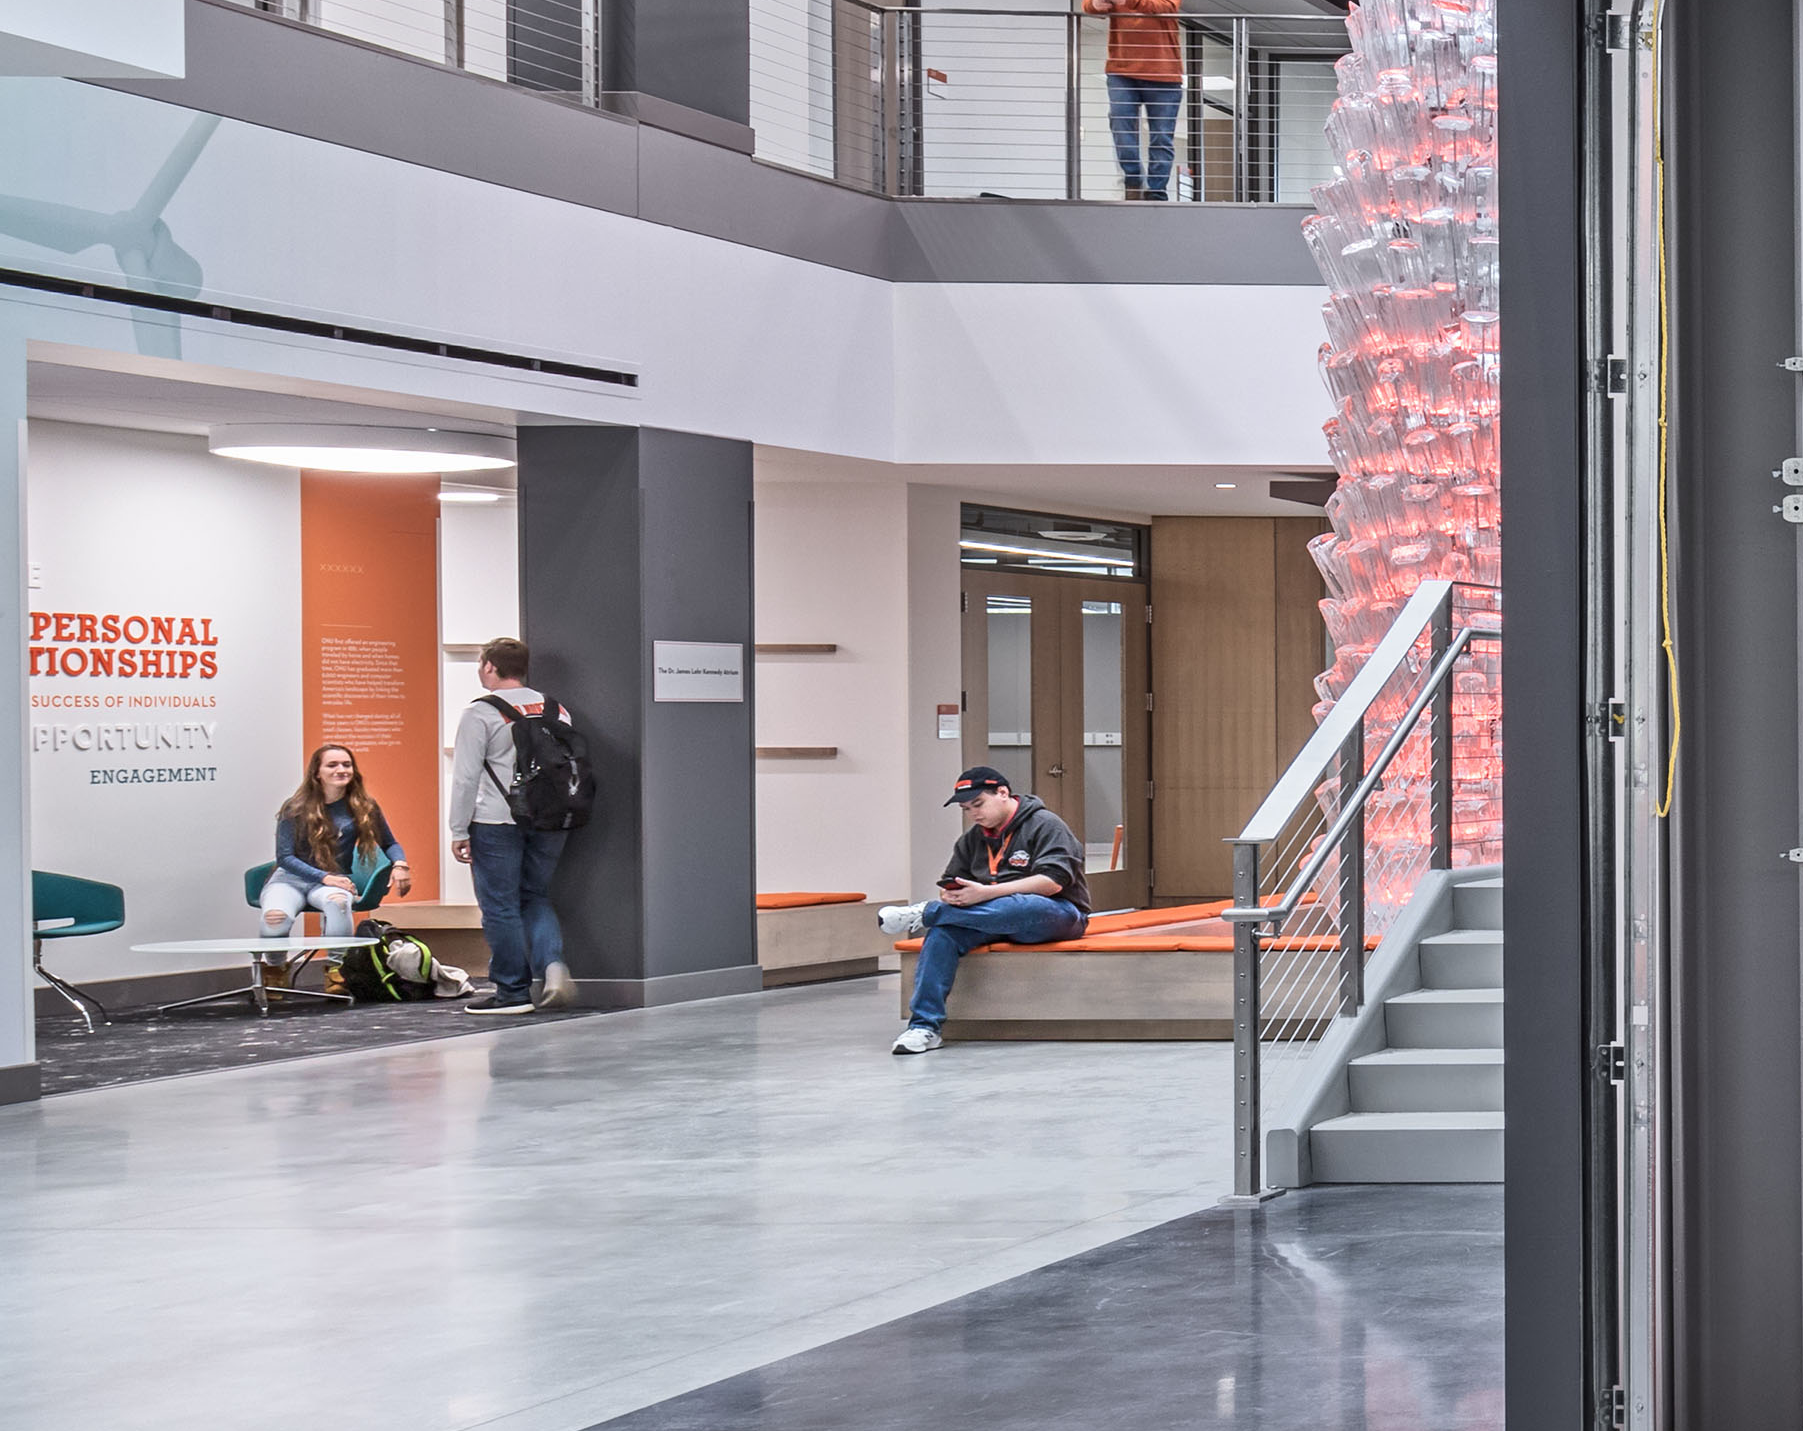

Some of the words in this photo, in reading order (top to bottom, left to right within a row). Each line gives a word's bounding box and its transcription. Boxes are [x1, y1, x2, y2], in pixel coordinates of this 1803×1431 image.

[29, 612, 218, 646] PERSONAL
[29, 646, 218, 679] TIONSHIPS
[31, 695, 100, 708] SUCCESS
[104, 695, 124, 708] OF
[128, 695, 217, 708] INDIVIDUALS
[32, 721, 217, 752] PPORTUNITY
[90, 766, 217, 785] ENGAGEMENT
